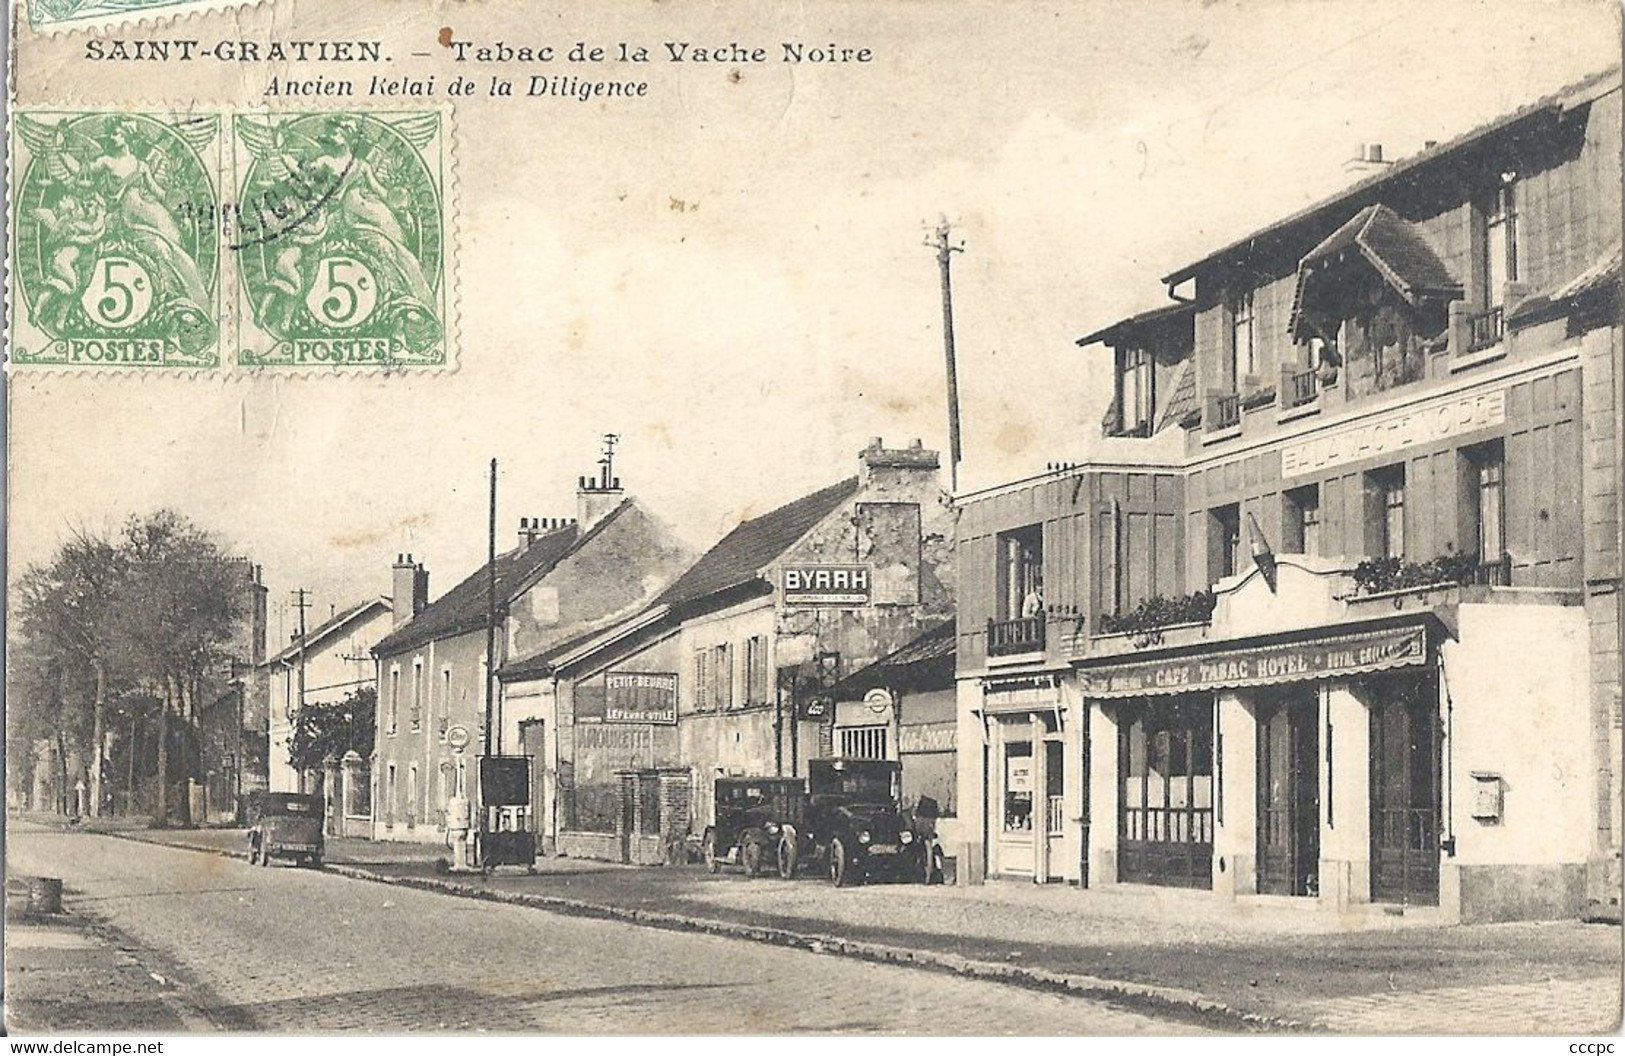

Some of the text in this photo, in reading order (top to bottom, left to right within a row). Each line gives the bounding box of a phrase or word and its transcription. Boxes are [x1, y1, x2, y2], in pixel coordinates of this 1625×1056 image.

[86, 40, 873, 62] SAINT-GRATIEN. Tabac de la Vache Noire
[264, 76, 353, 96] Ancien
[447, 76, 475, 96] de
[489, 76, 512, 96] la
[527, 75, 648, 102] Diligence
[72, 341, 160, 361] POSTES
[297, 341, 387, 361] POSTES
[1199, 660, 1249, 682] TABAC
[1257, 654, 1308, 678] HOTEL
